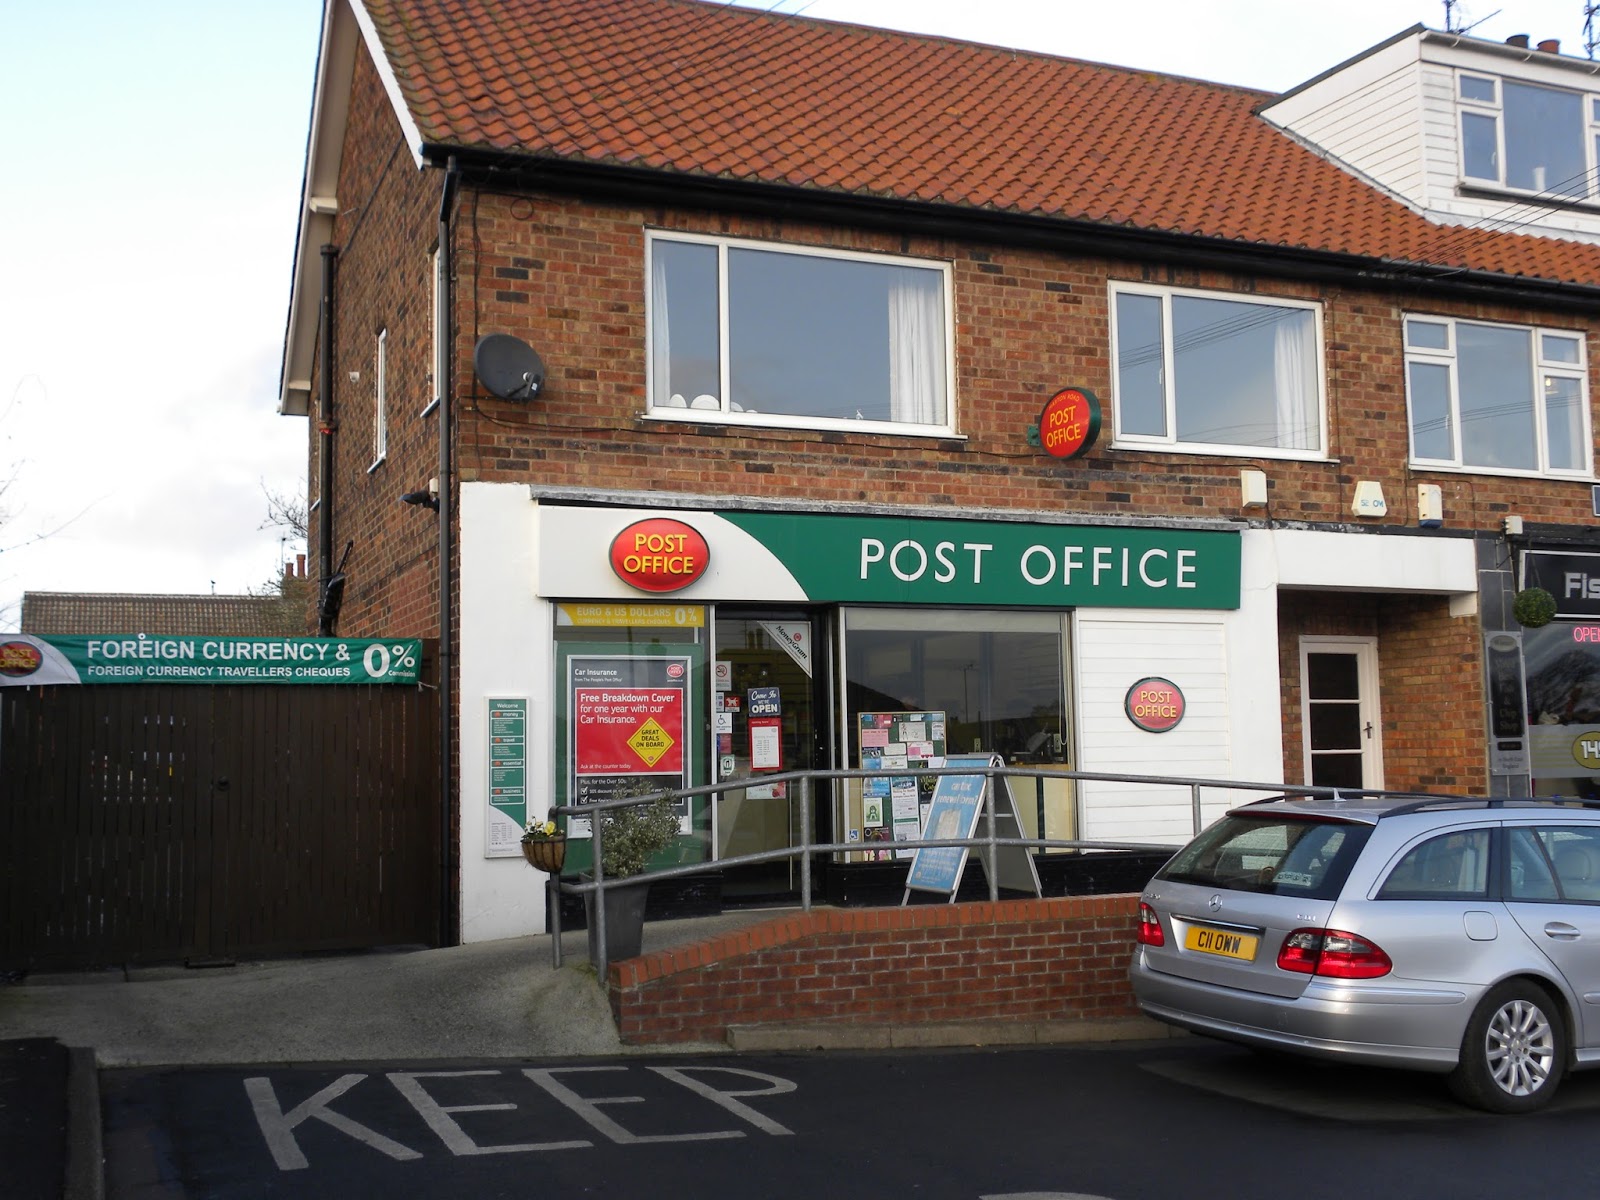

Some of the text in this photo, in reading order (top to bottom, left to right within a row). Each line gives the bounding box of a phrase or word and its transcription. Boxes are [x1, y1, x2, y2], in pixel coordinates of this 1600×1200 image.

[1049, 405, 1077, 428] POST
[1046, 423, 1081, 448] OFFICE
[635, 533, 688, 553] POST
[623, 555, 694, 574] OFFICE
[860, 538, 1196, 588] POST OFFICE
[576, 607, 671, 617] EURO & US DOLLARS
[1573, 626, 1600, 642] OPE
[776, 625, 807, 660] MoneyGram
[3, 649, 32, 658] POST
[87, 640, 350, 661] FOREIGN CURRENCY &
[0, 658, 36, 668] OFFICE
[363, 643, 415, 678] 0%
[87, 666, 350, 677] FOREIGN CURRENCY TRAVELLERS CHEQUES
[574, 668, 617, 676] Car Insurance
[580, 693, 675, 702] Free Breakdown Cover
[751, 690, 767, 701] Come
[1141, 690, 1172, 703] POST
[580, 704, 592, 713] for
[610, 706, 628, 714] year
[630, 704, 648, 713] with
[751, 704, 778, 714] OPEN
[1134, 705, 1177, 718] OFFICE
[580, 714, 637, 724] Car Insurance.
[1580, 740, 1600, 759] 14
[242, 1065, 798, 1171] KEEP
